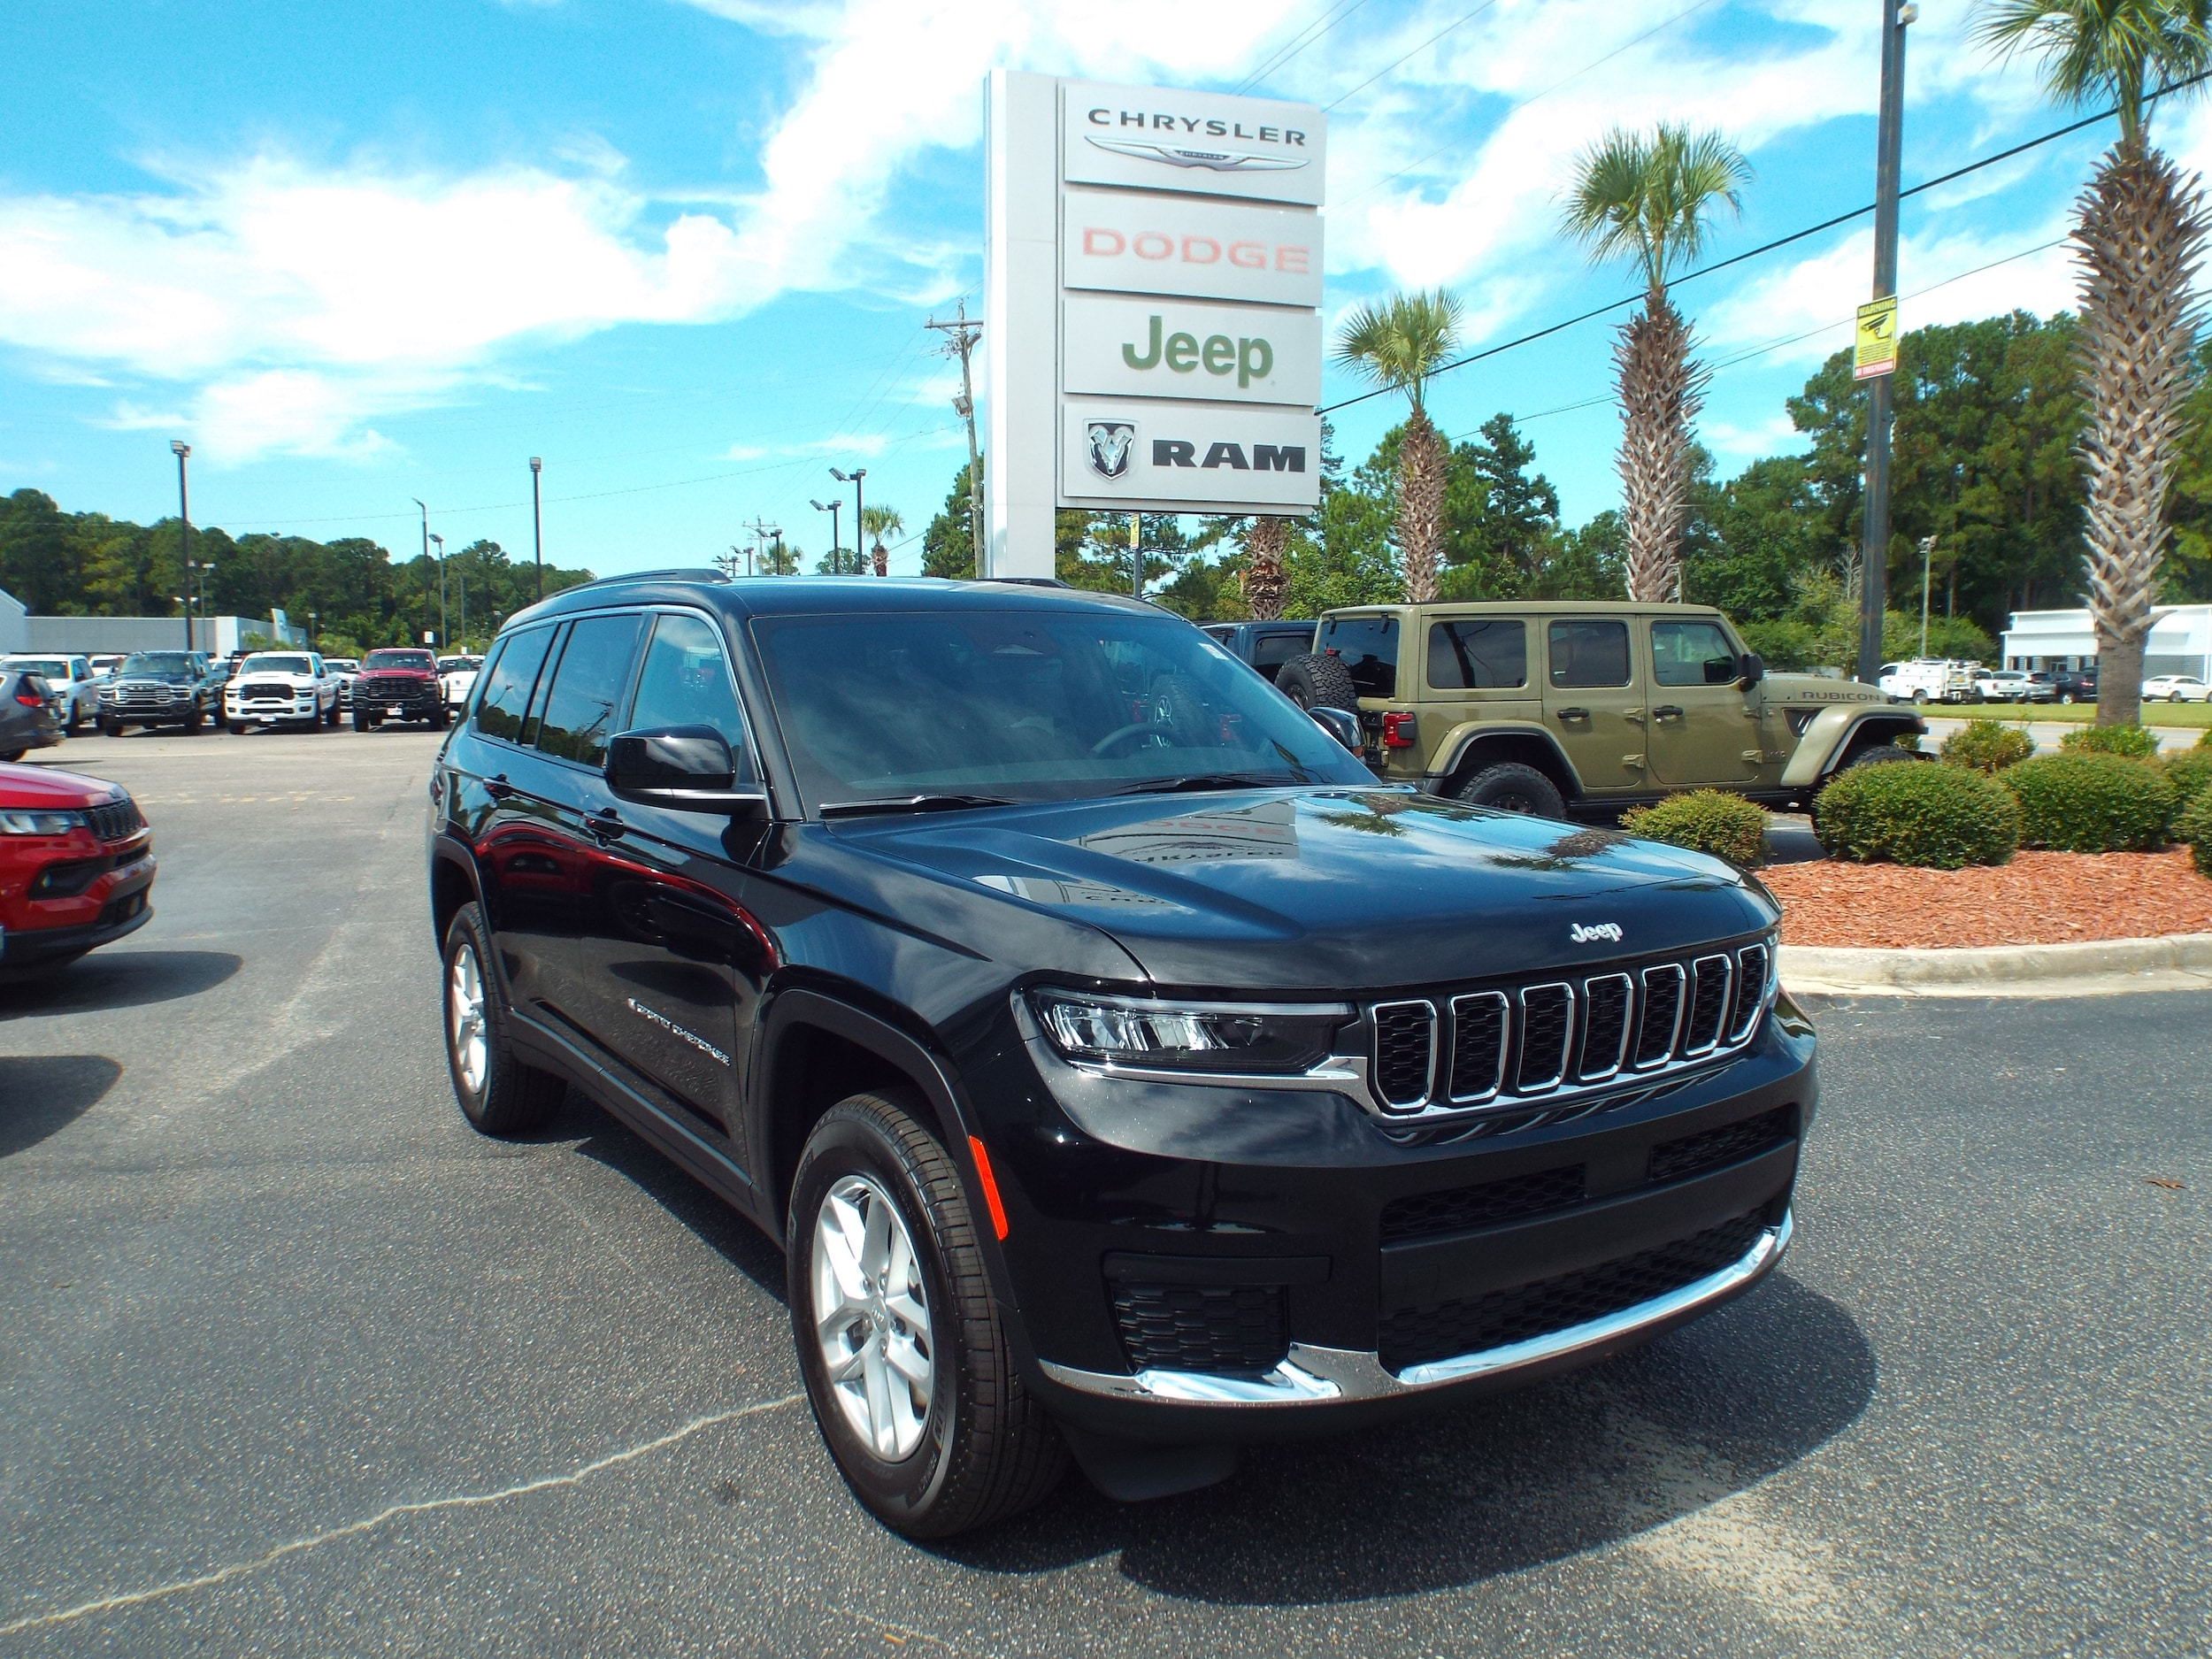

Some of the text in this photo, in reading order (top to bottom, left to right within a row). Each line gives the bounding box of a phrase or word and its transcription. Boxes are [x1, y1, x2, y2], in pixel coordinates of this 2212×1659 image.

[1088, 108, 1306, 146] CHRYSLER
[1083, 227, 1310, 274] DODGE
[1122, 315, 1273, 389] Jeep
[1153, 439, 1306, 473] RAM
[1801, 691, 1880, 702] RUBICON
[1570, 922, 1624, 944] Jeep
